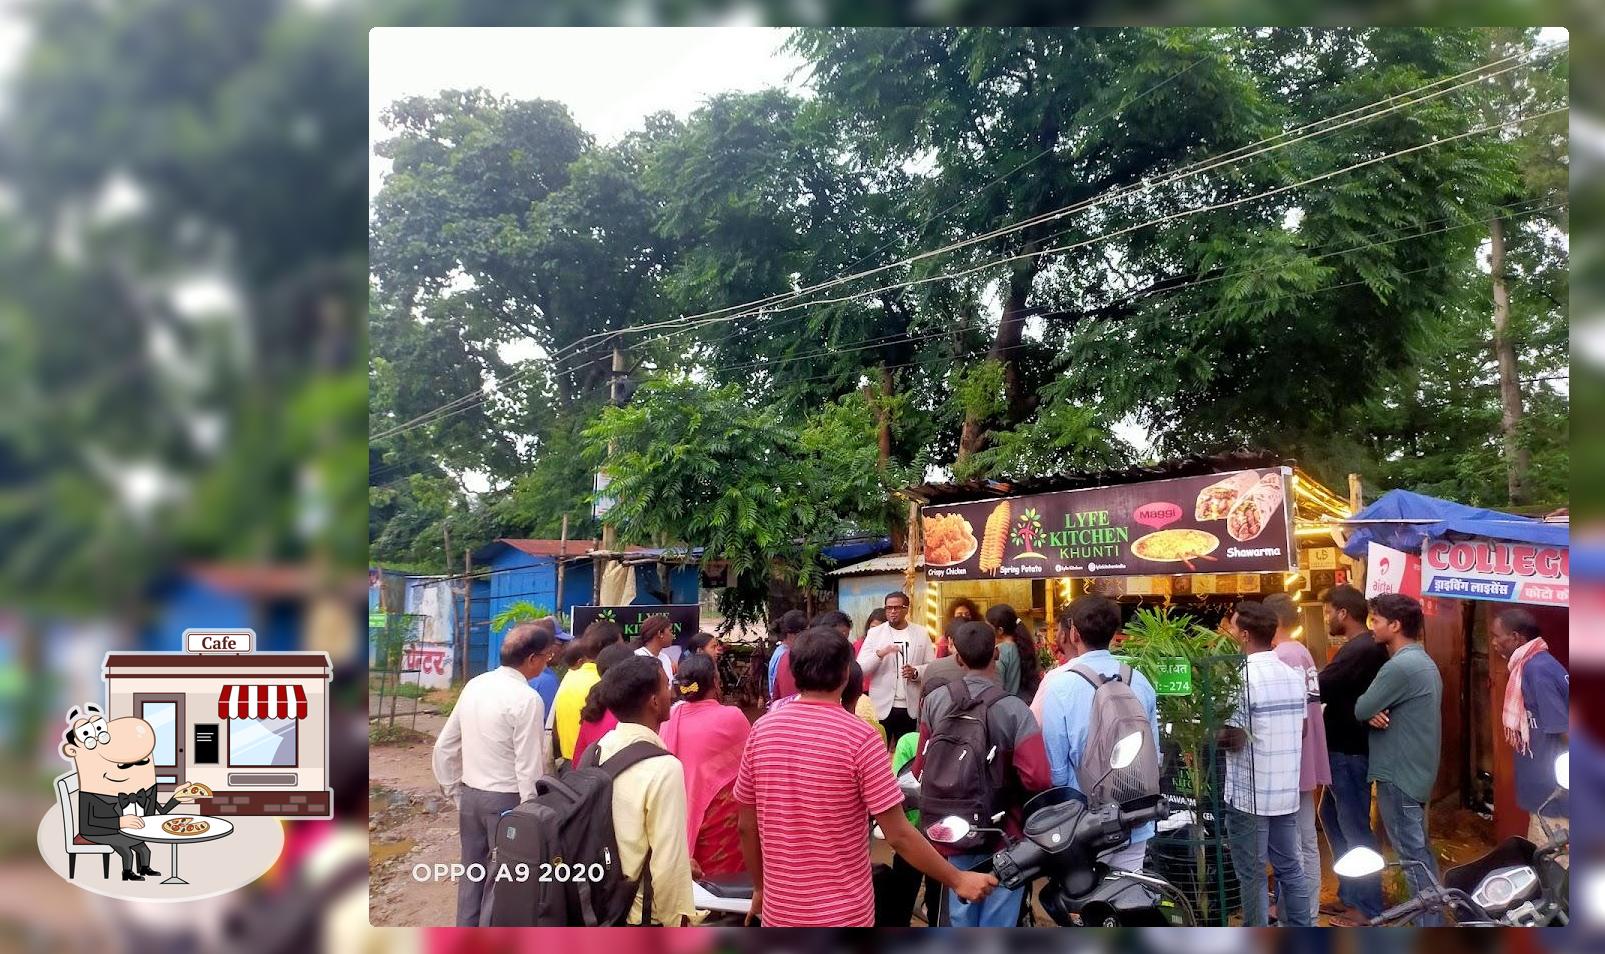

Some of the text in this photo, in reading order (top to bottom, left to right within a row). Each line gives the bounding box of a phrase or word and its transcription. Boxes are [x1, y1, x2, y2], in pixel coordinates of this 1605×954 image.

[1064, 511, 1110, 528] LYFE
[1140, 508, 1176, 519] Maggi
[1050, 527, 1129, 547] KITCHEN
[1060, 545, 1119, 559] KHUNTI
[1226, 547, 1281, 558] Shawarma
[928, 567, 967, 577] Crispy Chicken
[1000, 564, 1043, 576] Spring Potato
[1372, 579, 1393, 595] airtel
[1434, 578, 1469, 592] ड्राइविंग
